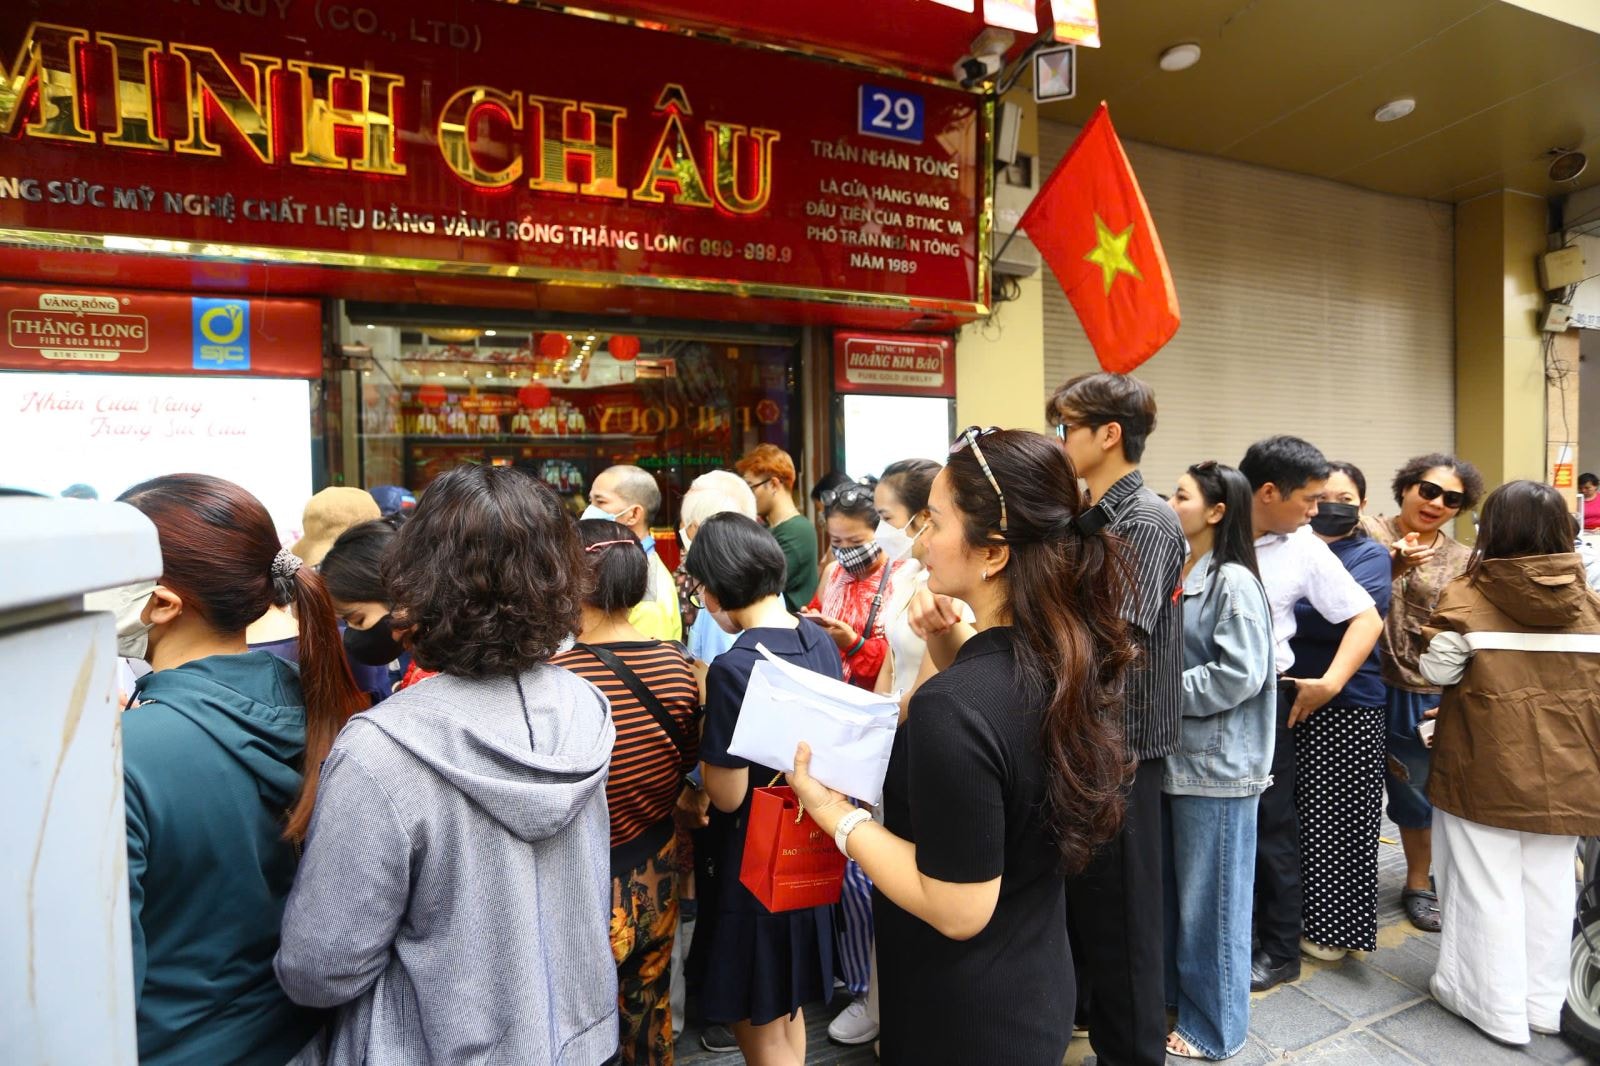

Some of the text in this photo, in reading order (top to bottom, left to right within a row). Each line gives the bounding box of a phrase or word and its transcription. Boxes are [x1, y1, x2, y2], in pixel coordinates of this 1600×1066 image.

[409, 20, 482, 53] LTD)
[0, 22, 781, 214] MINH CHÂU
[871, 93, 916, 131] 29
[913, 154, 960, 180] TÔNG
[47, 177, 106, 208] SỨC
[113, 184, 156, 212] MỸ
[163, 191, 237, 225] NGHỆ
[242, 195, 308, 224] CHẤT
[315, 201, 366, 231] LIỆU
[442, 210, 501, 239] VÀNG
[569, 225, 640, 251] THĂNG
[644, 232, 695, 255] LONG
[905, 214, 944, 233] BTMC
[923, 238, 961, 258] TÔNG
[887, 258, 918, 274] 1989
[12, 317, 144, 339] THĂNG LONG
[40, 337, 61, 345] FINE
[65, 338, 90, 346] GOLD
[891, 354, 914, 369] KIM
